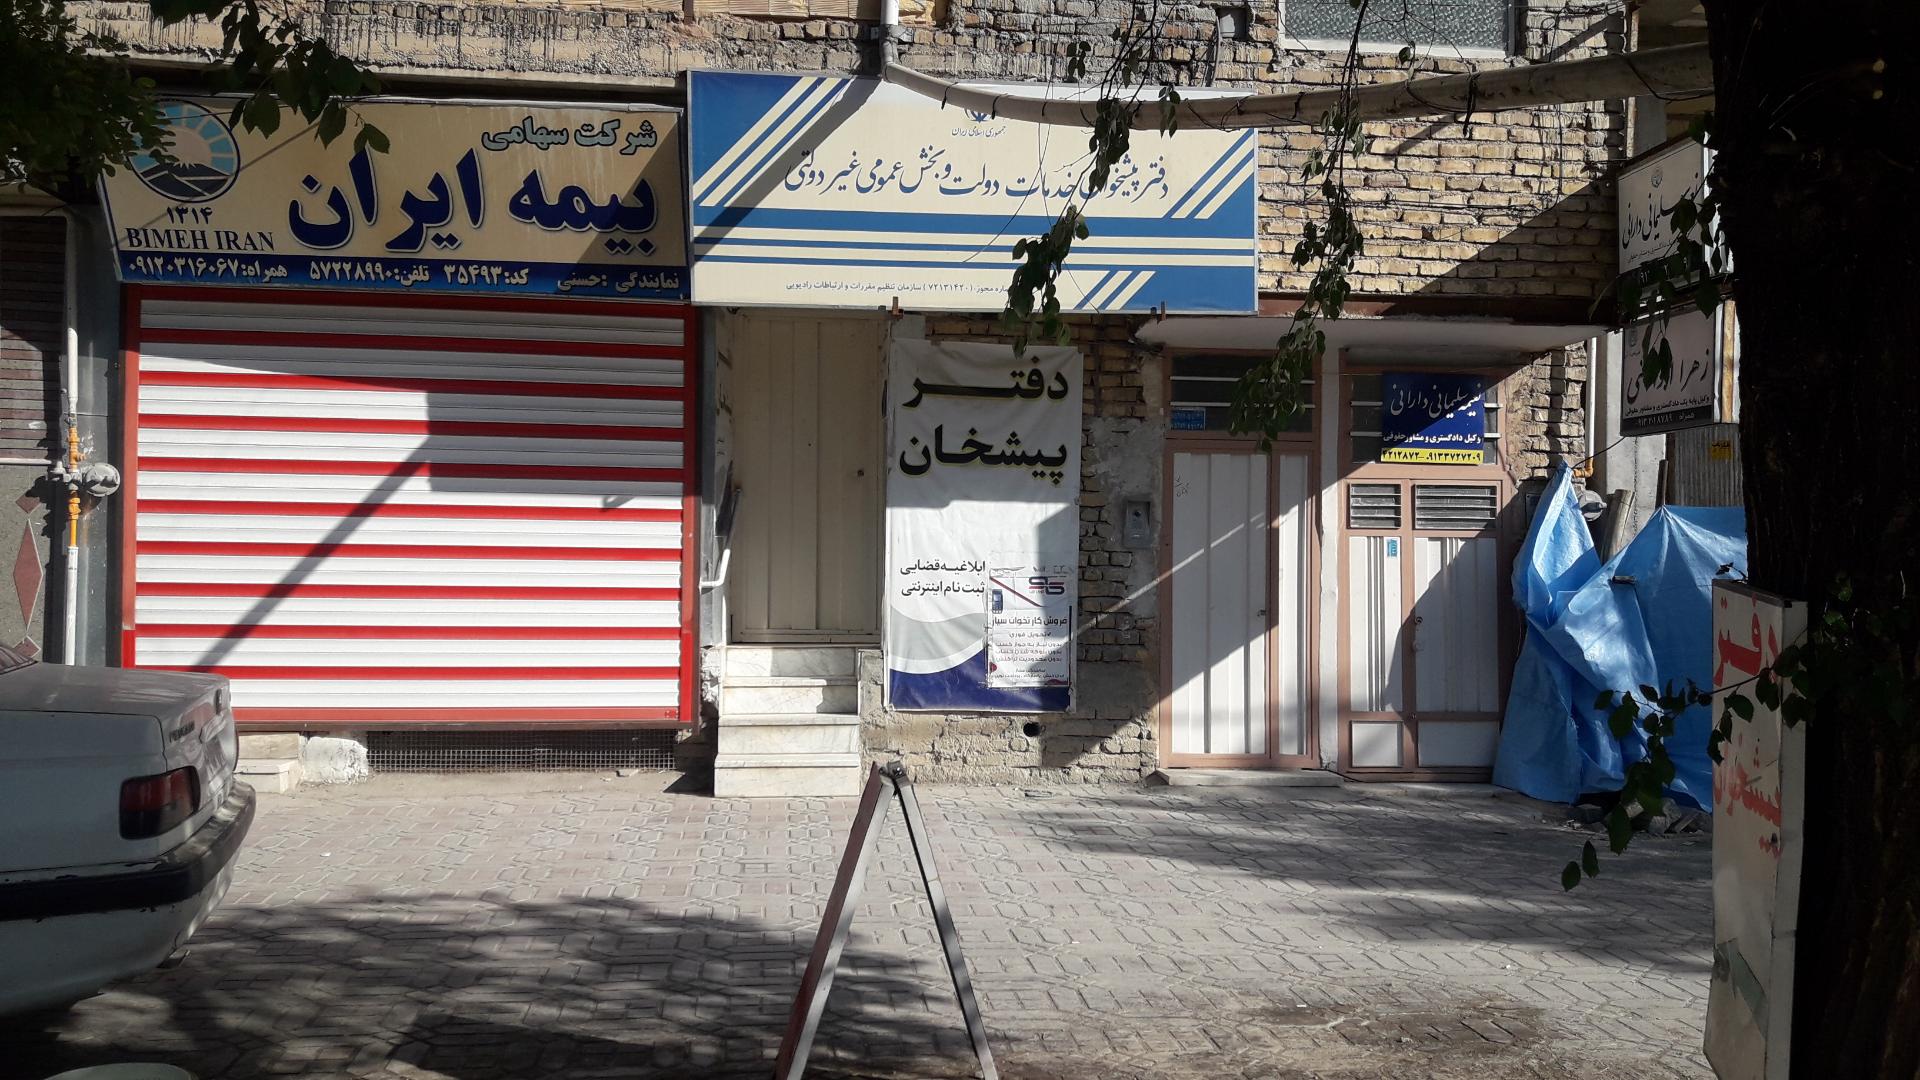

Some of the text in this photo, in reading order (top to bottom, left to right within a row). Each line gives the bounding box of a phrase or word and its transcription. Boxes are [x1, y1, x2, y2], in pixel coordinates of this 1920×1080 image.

[481, 115, 658, 155] شرکت سهامی
[784, 149, 825, 192] دولتی
[824, 149, 860, 196] غیر
[856, 155, 903, 193] عمومی
[899, 145, 946, 194] بخش
[938, 163, 999, 197] دولت
[1130, 155, 1168, 203] دفتر
[166, 205, 213, 225] ۱۳۱۴
[288, 146, 659, 257] بیمه ایران
[124, 227, 275, 251] BIMEH IRAN
[615, 271, 680, 293] نمایندگی
[995, 284, 1009, 293] ماره
[902, 355, 1069, 408] دفتر
[1390, 384, 1429, 416] دارانی
[1428, 384, 1469, 419] سلیمانی
[1383, 431, 1406, 442] حقوقی
[1404, 433, 1424, 443] مشاور
[1429, 433, 1463, 444] دادگستری
[1464, 433, 1481, 444] وکیل
[899, 424, 1067, 485] پیشخان
[899, 558, 985, 576] ابلاغیه قضایی
[901, 581, 985, 597] ثبت نام اینترنتی
[992, 616, 1007, 626] سیار
[1043, 616, 1068, 626] فروش
